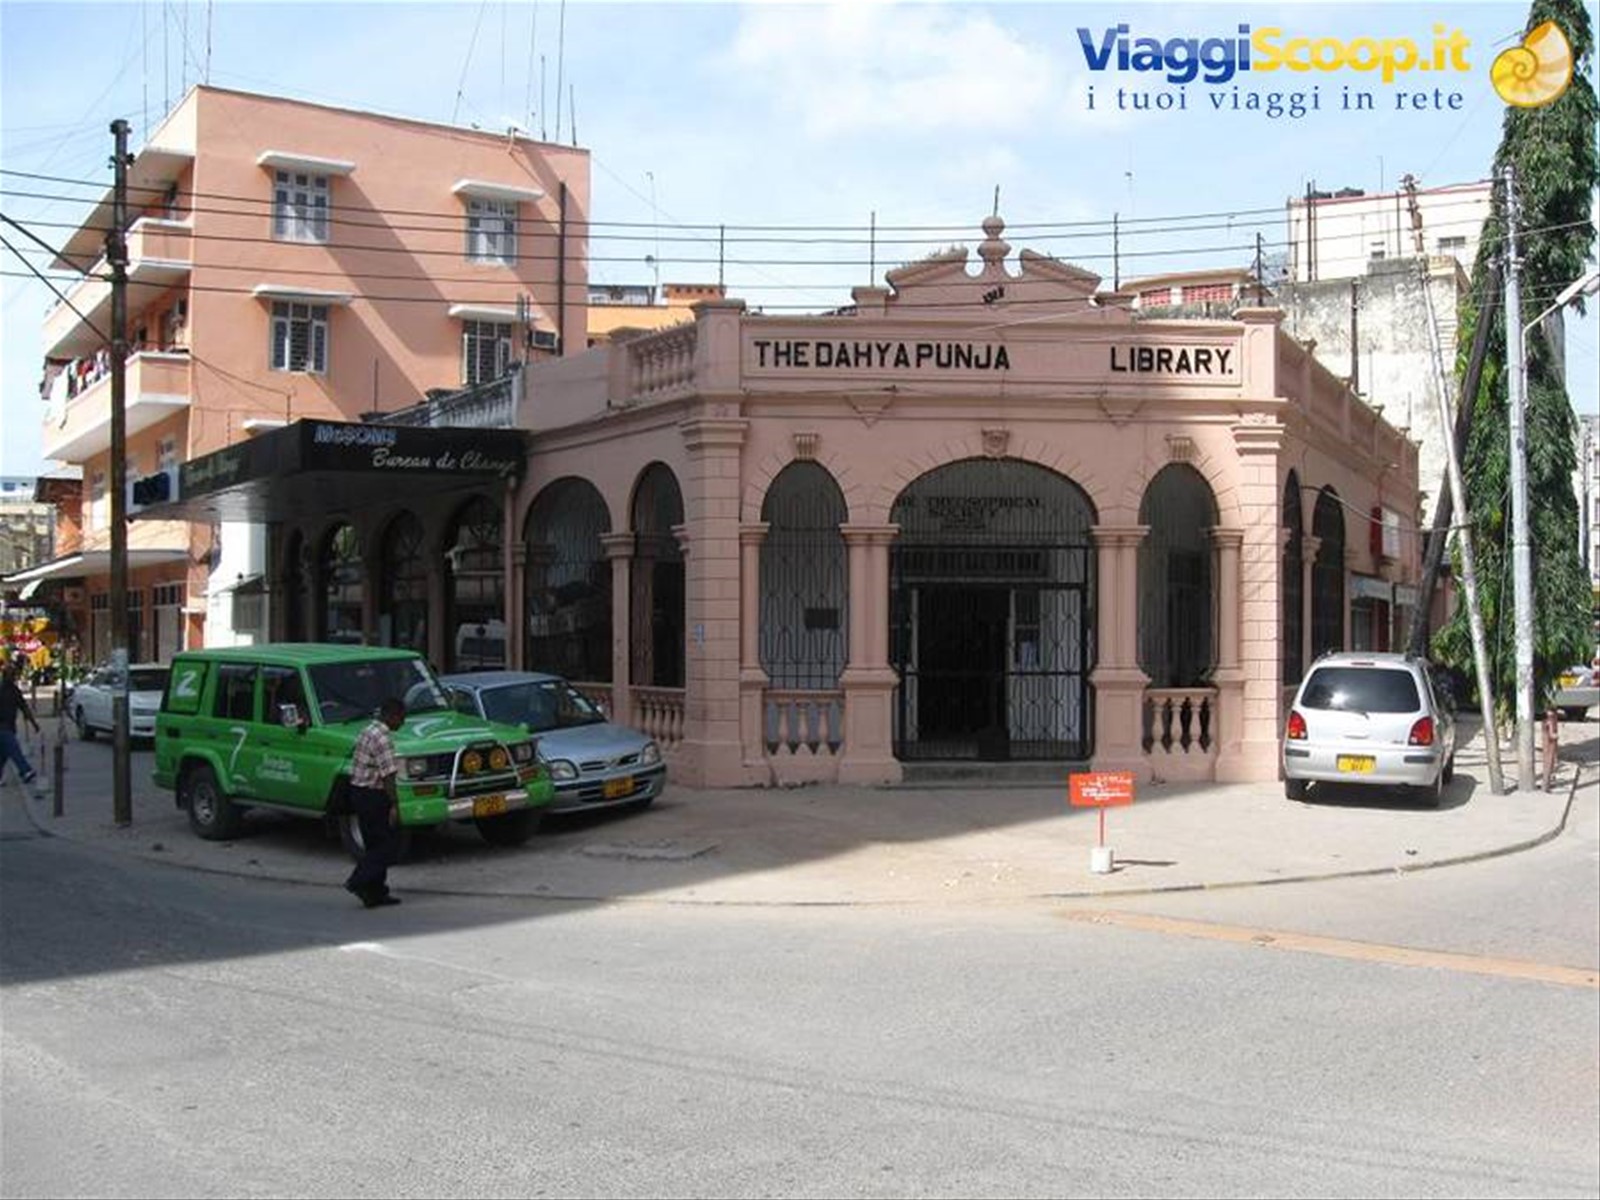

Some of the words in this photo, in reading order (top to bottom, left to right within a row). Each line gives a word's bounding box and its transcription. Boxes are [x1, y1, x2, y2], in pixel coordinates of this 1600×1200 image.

[754, 341, 810, 367] THE
[914, 343, 1010, 370] PUNJA
[1110, 345, 1234, 375] LIBRARY.
[372, 447, 430, 468] Bureau
[436, 450, 456, 469] de
